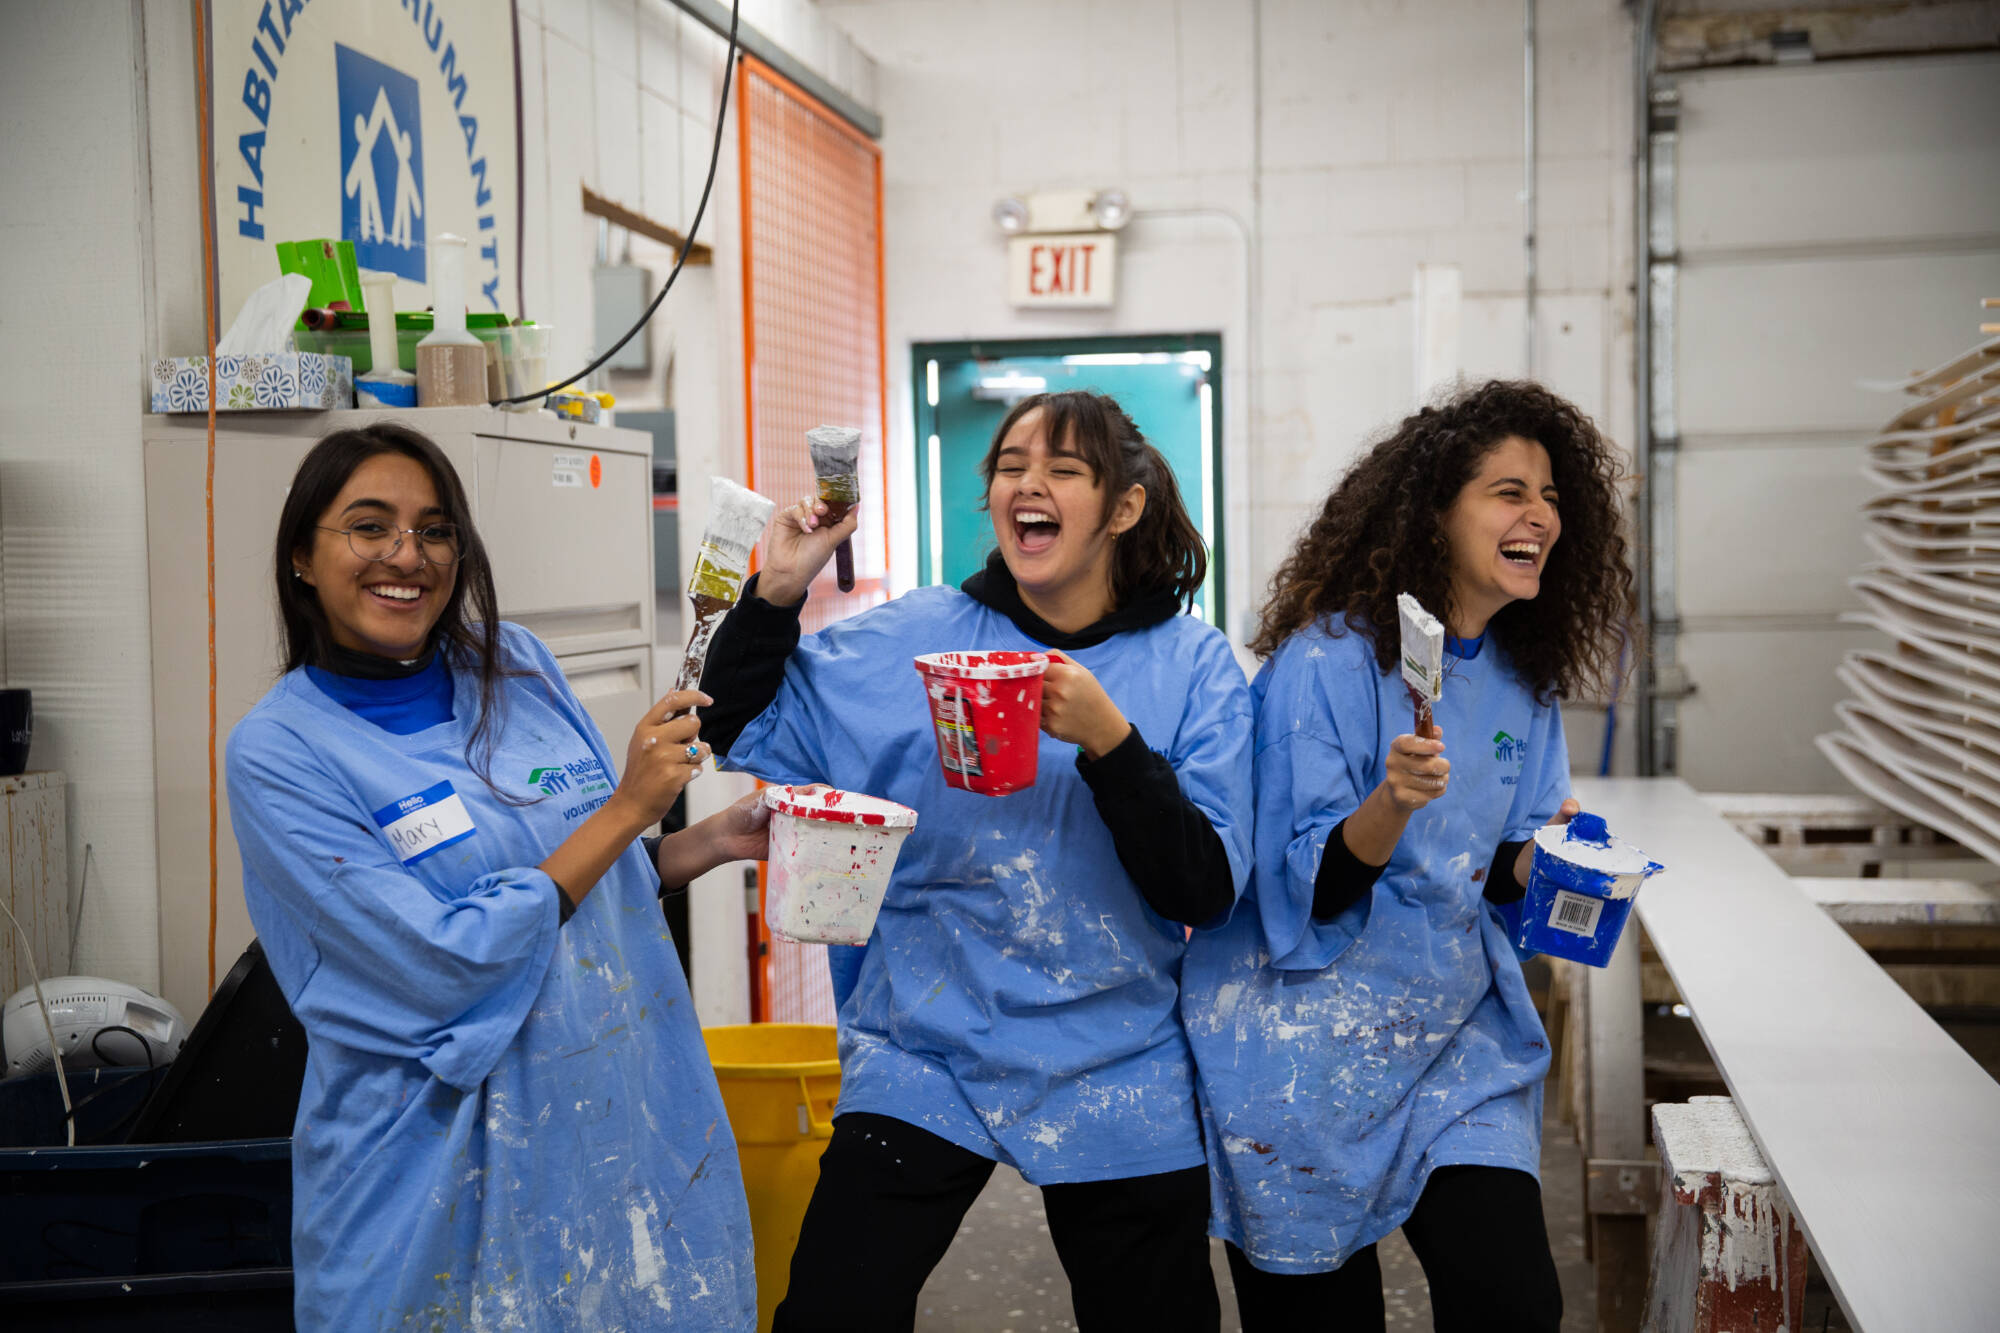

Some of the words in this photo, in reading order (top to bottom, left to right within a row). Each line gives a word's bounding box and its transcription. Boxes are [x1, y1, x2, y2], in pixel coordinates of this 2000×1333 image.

[237, 0, 311, 241] HABITA
[1029, 243, 1096, 296] EXIT
[398, 795, 425, 811] Hello
[563, 794, 613, 821] VOLUNTEE
[391, 817, 444, 855] Mary
